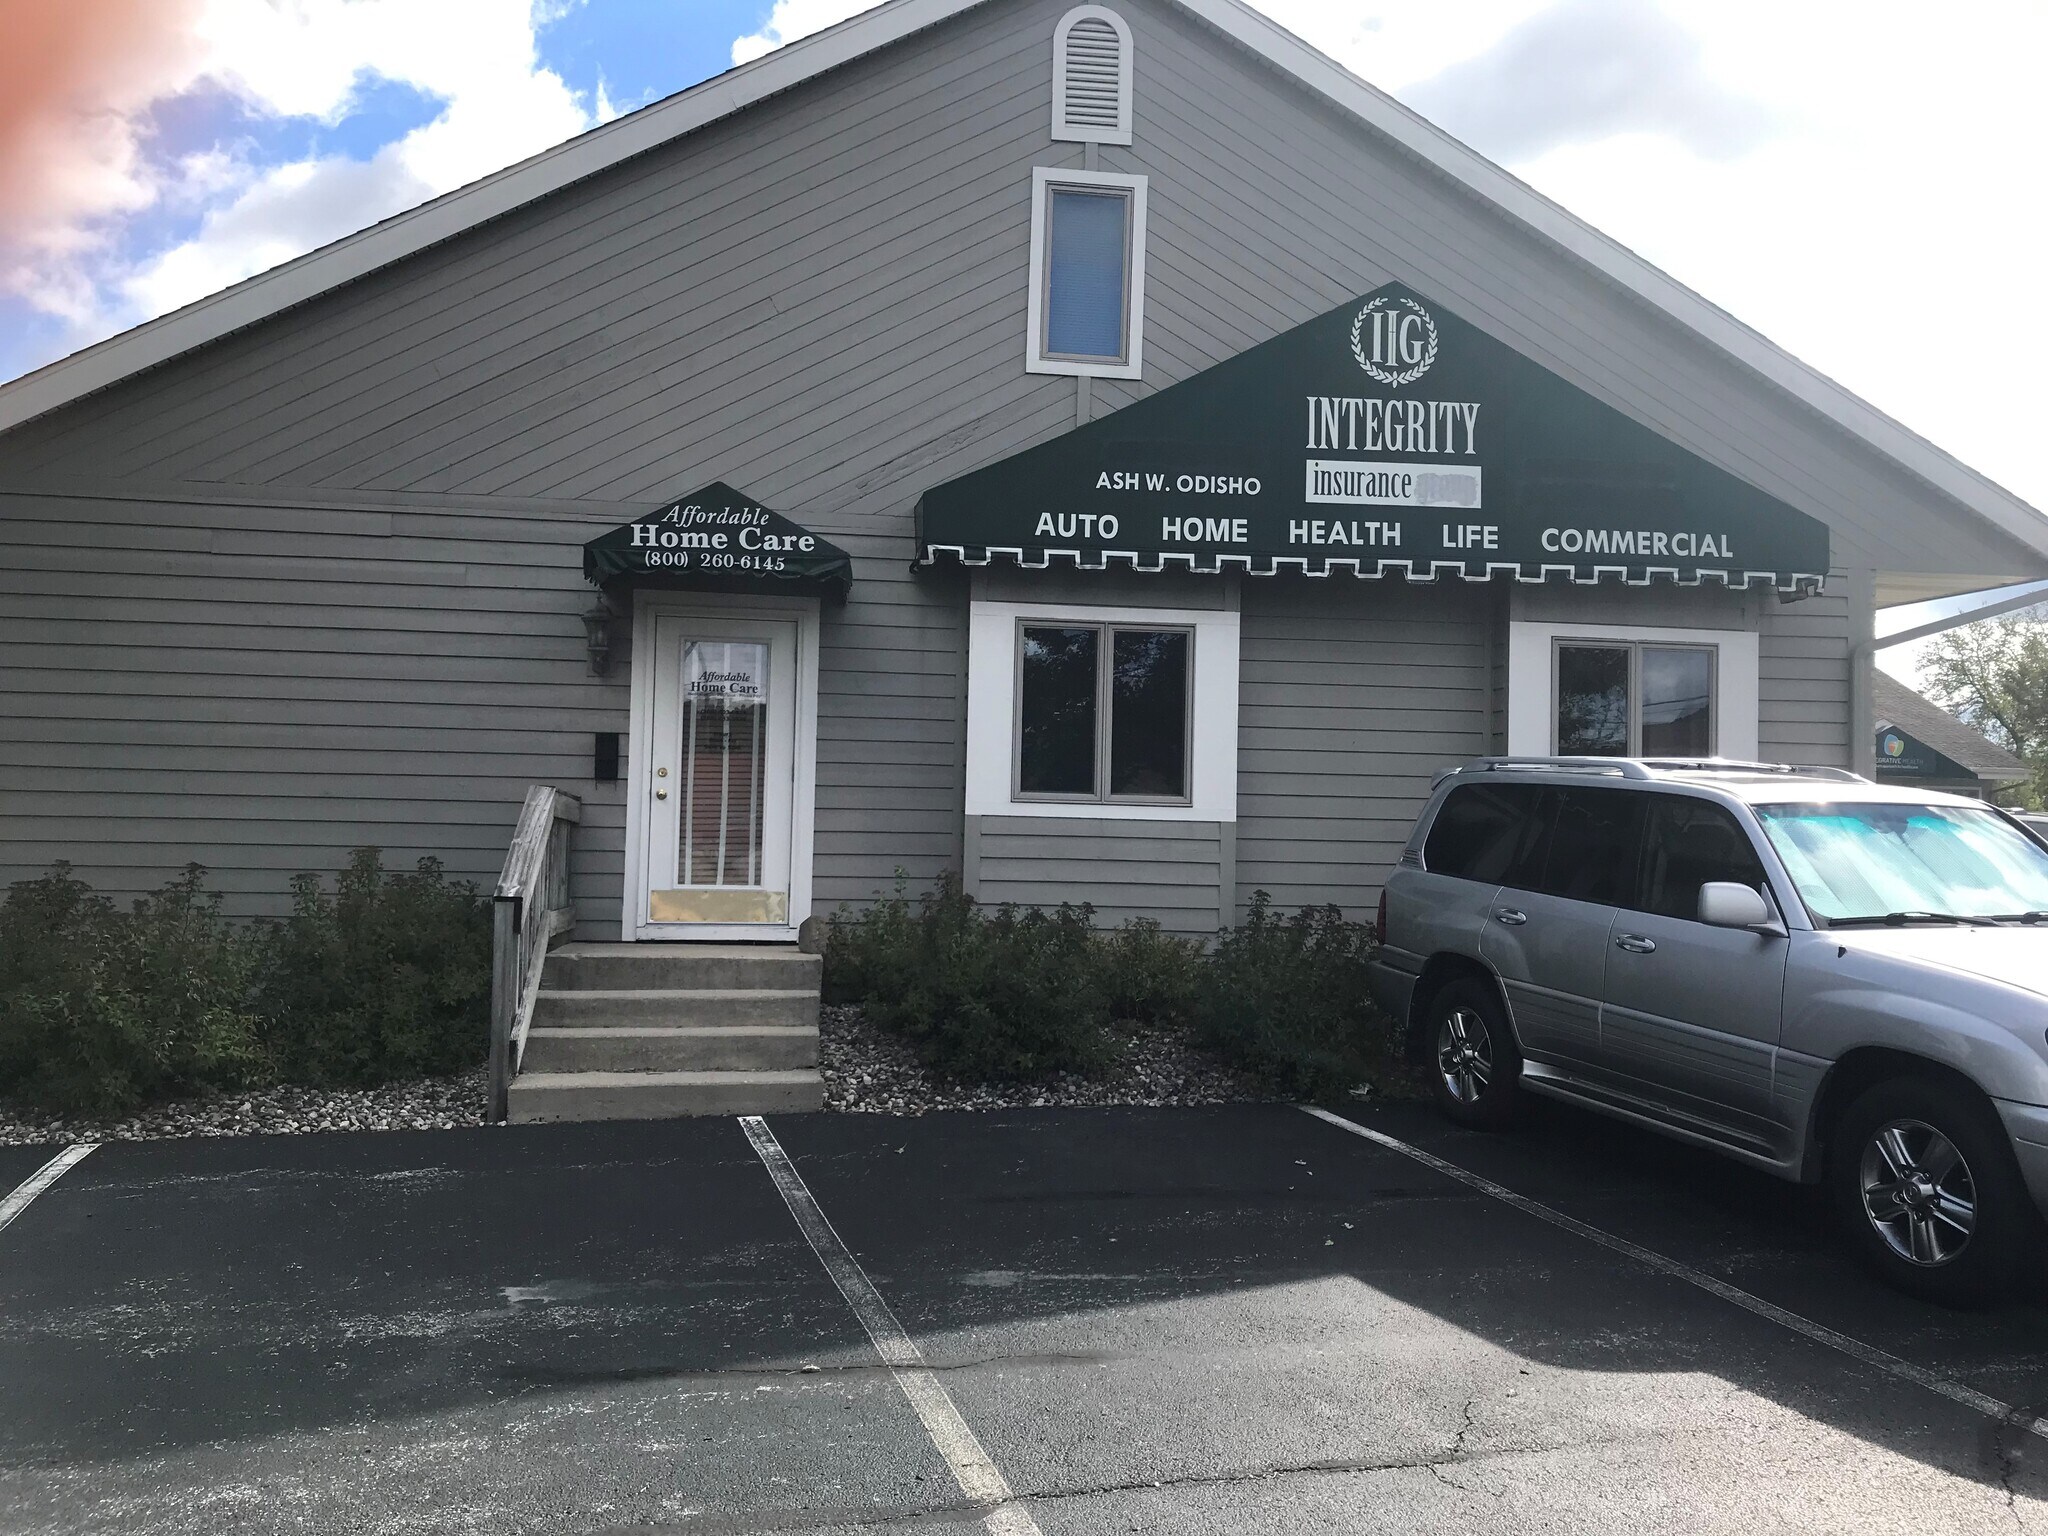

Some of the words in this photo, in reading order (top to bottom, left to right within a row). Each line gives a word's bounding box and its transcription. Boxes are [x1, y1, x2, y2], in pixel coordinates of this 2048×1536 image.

[1305, 396, 1482, 455] INTEGRITY
[1095, 471, 1140, 491] ASH
[1145, 473, 1170, 492] W.
[1176, 474, 1262, 496] ODISHO
[1313, 461, 1412, 499] insurance
[661, 505, 770, 528] Affordable
[630, 523, 729, 550] Home
[738, 527, 815, 552] Care
[1034, 512, 1120, 540] AUTO
[1161, 516, 1249, 543] HOME
[1289, 519, 1402, 547] HEALTH
[1442, 524, 1500, 550] LIFE
[1541, 527, 1735, 559] COMMERCIAL
[644, 550, 690, 568] (800)
[699, 552, 786, 572] 260-6145
[690, 681, 726, 693] Home
[729, 682, 758, 694] Care
[699, 671, 751, 684] Affordable
